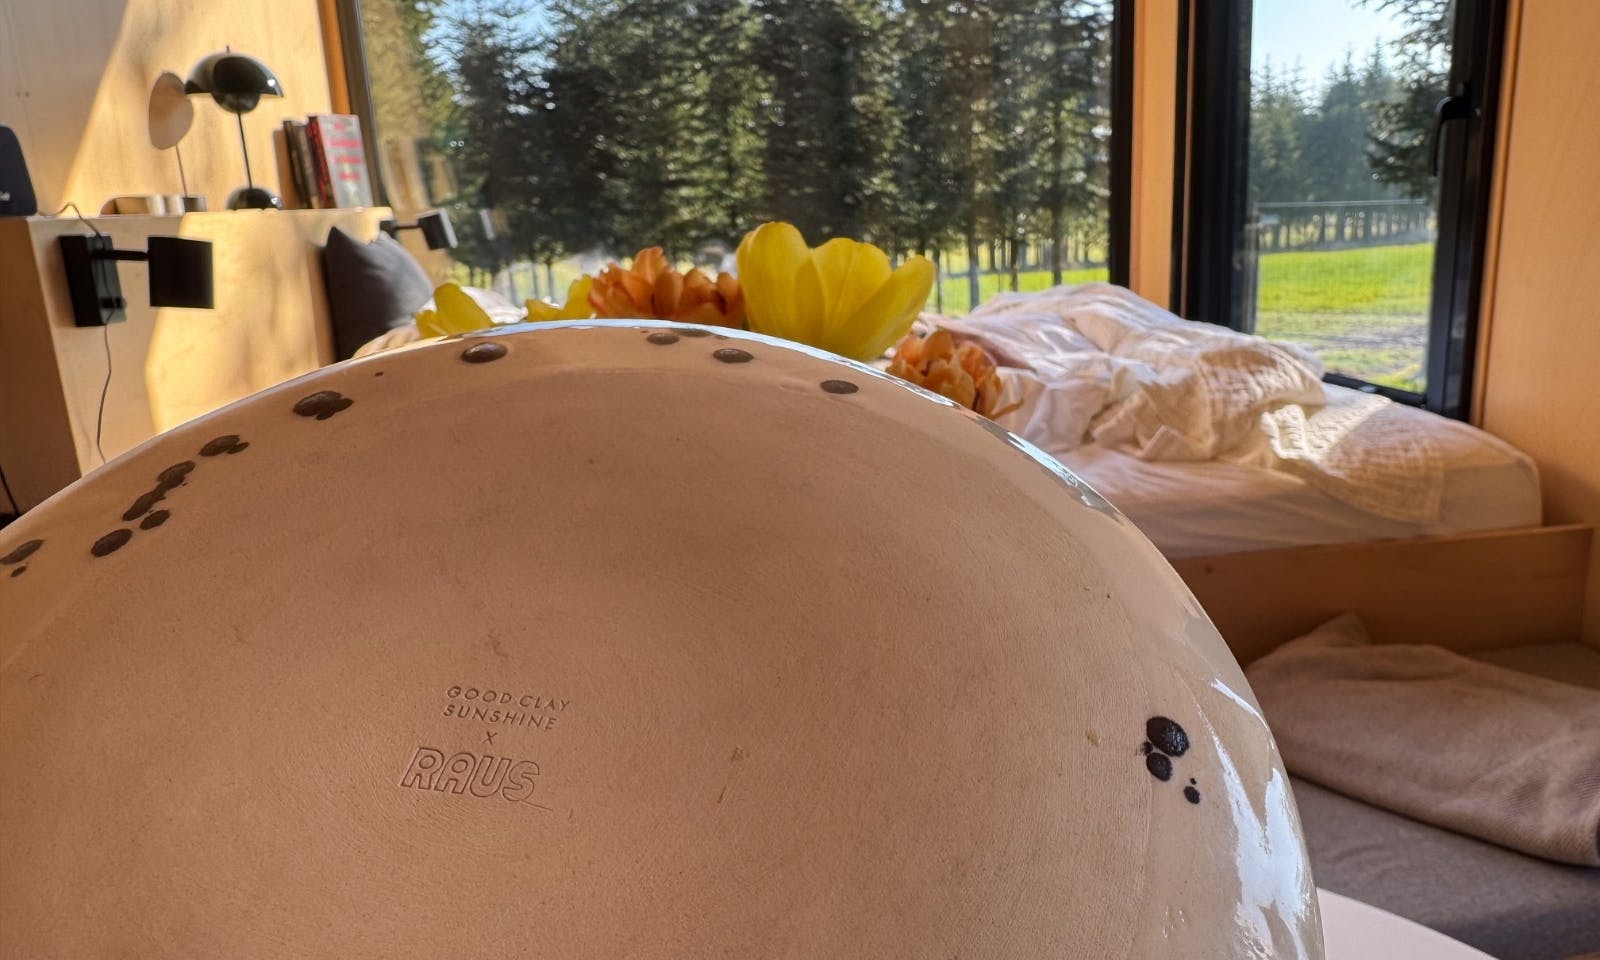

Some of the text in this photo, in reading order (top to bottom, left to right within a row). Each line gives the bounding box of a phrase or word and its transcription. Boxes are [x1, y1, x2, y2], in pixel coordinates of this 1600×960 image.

[446, 685, 571, 712] GOOD CLAY
[443, 703, 558, 731] SUNSHINE
[400, 746, 541, 802] RAUS
